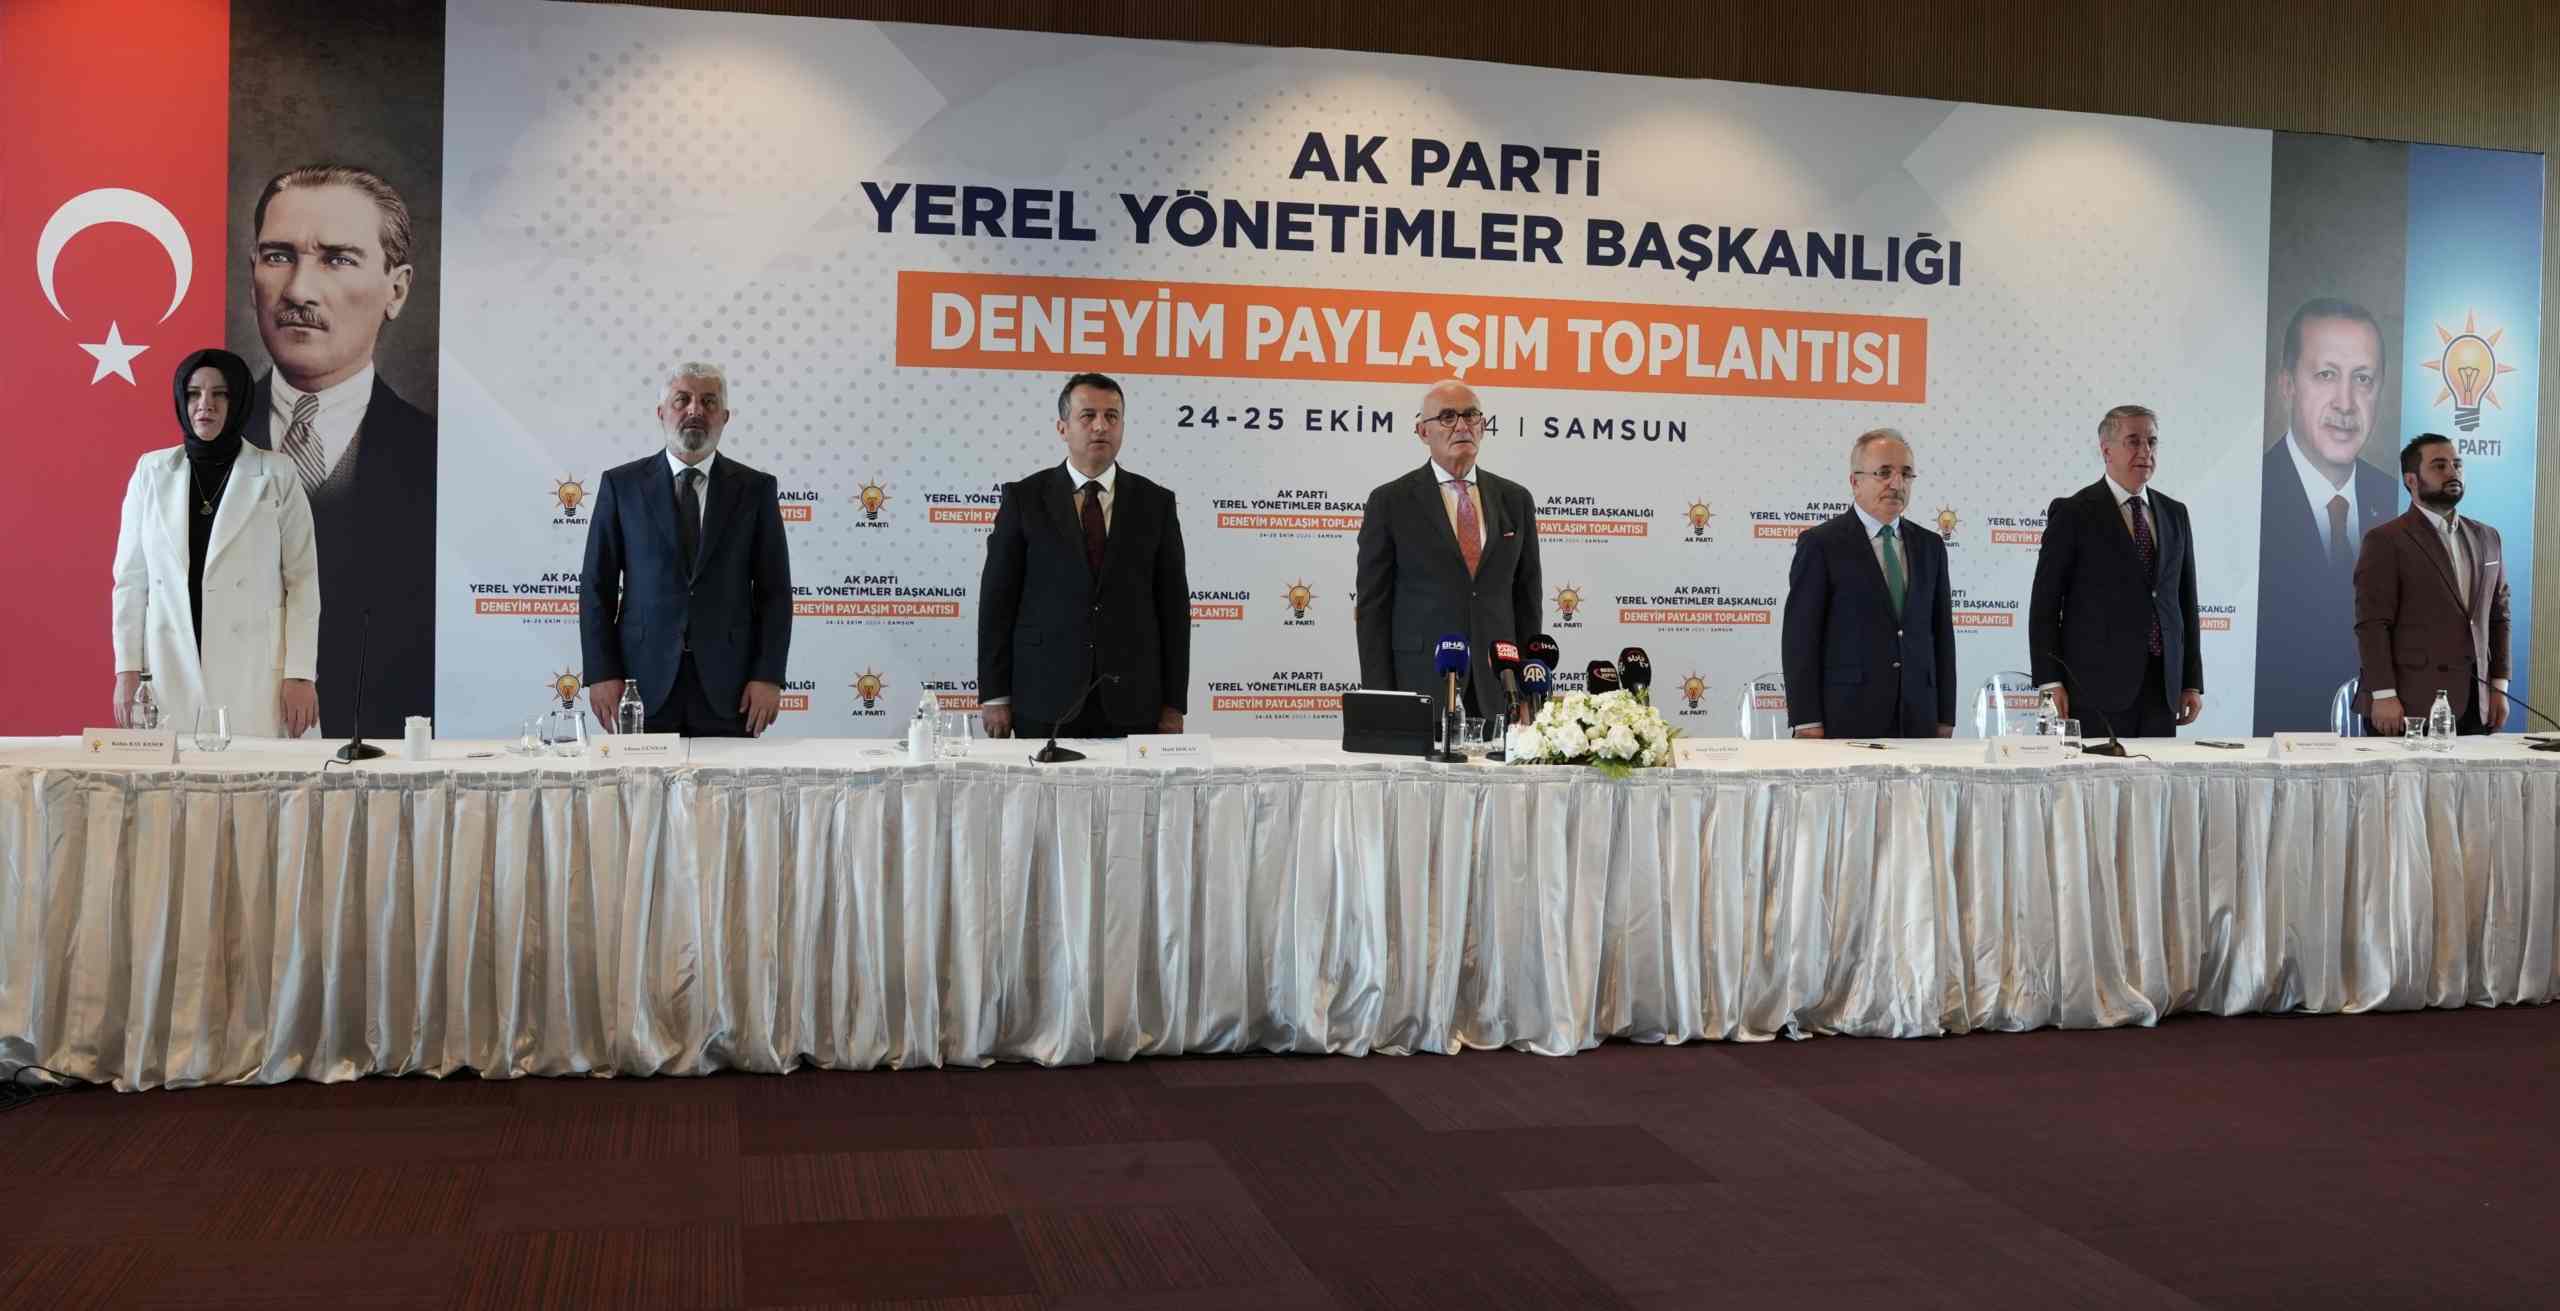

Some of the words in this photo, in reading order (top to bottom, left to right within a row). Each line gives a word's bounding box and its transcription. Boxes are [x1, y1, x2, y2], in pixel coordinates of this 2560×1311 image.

[1289, 131, 1388, 184] AK
[860, 181, 1097, 242] YEREL
[1587, 219, 1962, 287] BAŞKANLIĞI
[930, 287, 1225, 359] DENEYİM
[1245, 304, 1549, 379] PAYLAŞIM
[1567, 318, 1901, 386] TOPLANTISI
[1177, 405, 1286, 431] 24-25
[1305, 404, 1394, 434] EKİM
[1543, 415, 1688, 443] SAMSUN
[778, 489, 819, 501] ANLIĞI
[924, 493, 962, 504] YEREL
[1277, 490, 1292, 499] AK
[1212, 499, 1248, 509] YEREL
[1547, 496, 1562, 505] AK
[1806, 502, 1820, 511] AK
[1591, 507, 1655, 518] BAŞKANLIĞI
[1750, 511, 1781, 520] YEREL
[855, 521, 867, 529] AK
[1987, 517, 2016, 527] YEREL
[1590, 524, 1643, 536] TOPLANTISI
[541, 573, 559, 582] AK
[844, 575, 860, 584] AK
[470, 583, 509, 593] YEREL
[792, 586, 813, 596] REL
[895, 587, 966, 598] BAŞKANLIĞI
[1674, 586, 1688, 595] AK
[1190, 590, 1250, 601] AŞKANLIĞI
[1616, 595, 1648, 605] YEREL
[792, 602, 834, 614] ENEYİM
[893, 604, 954, 616] TOPLANTISI
[1714, 613, 1768, 623] TOPLANTISI
[1272, 672, 1288, 681] AK
[1524, 667, 1546, 682] AA
[1560, 672, 1586, 681] PART
[1208, 682, 1243, 691] YEREL
[1755, 682, 1776, 691] EREL
[852, 709, 864, 717] AK
